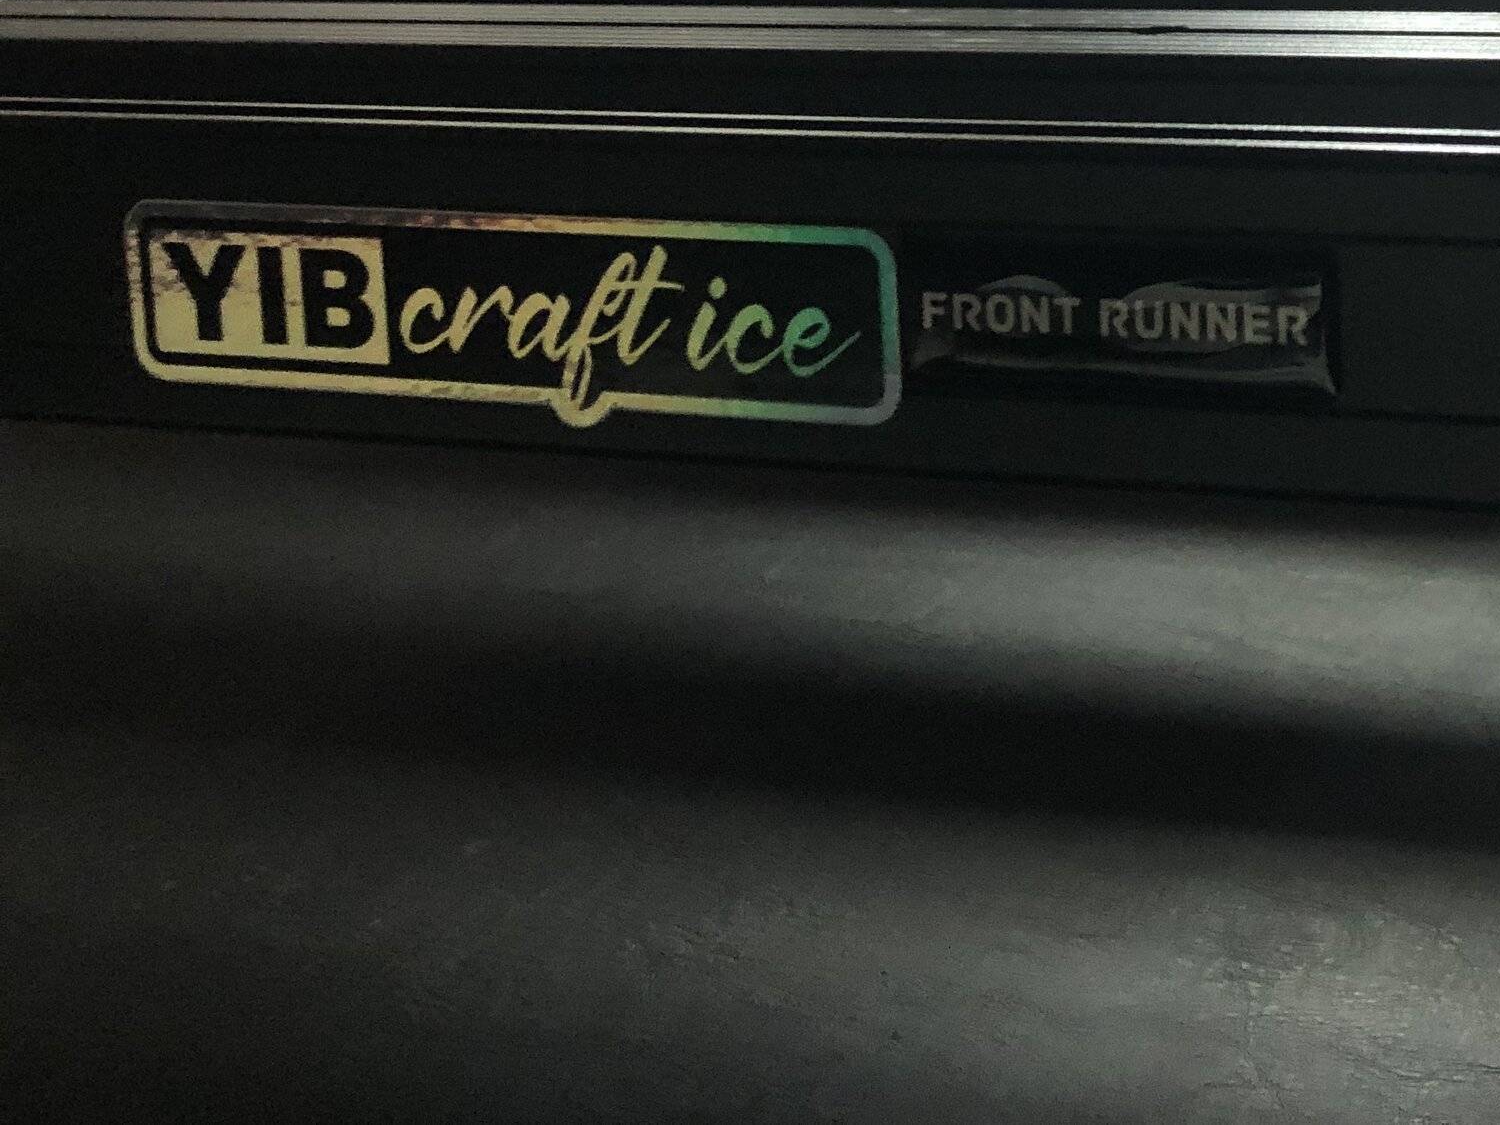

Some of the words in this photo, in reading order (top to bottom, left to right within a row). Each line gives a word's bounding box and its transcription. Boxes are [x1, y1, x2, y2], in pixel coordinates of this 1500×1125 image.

[163, 241, 376, 349] YIB
[399, 244, 684, 406] craft
[686, 277, 860, 376] ice
[921, 291, 1081, 335] FRONT
[1100, 297, 1309, 346] RUNNER
